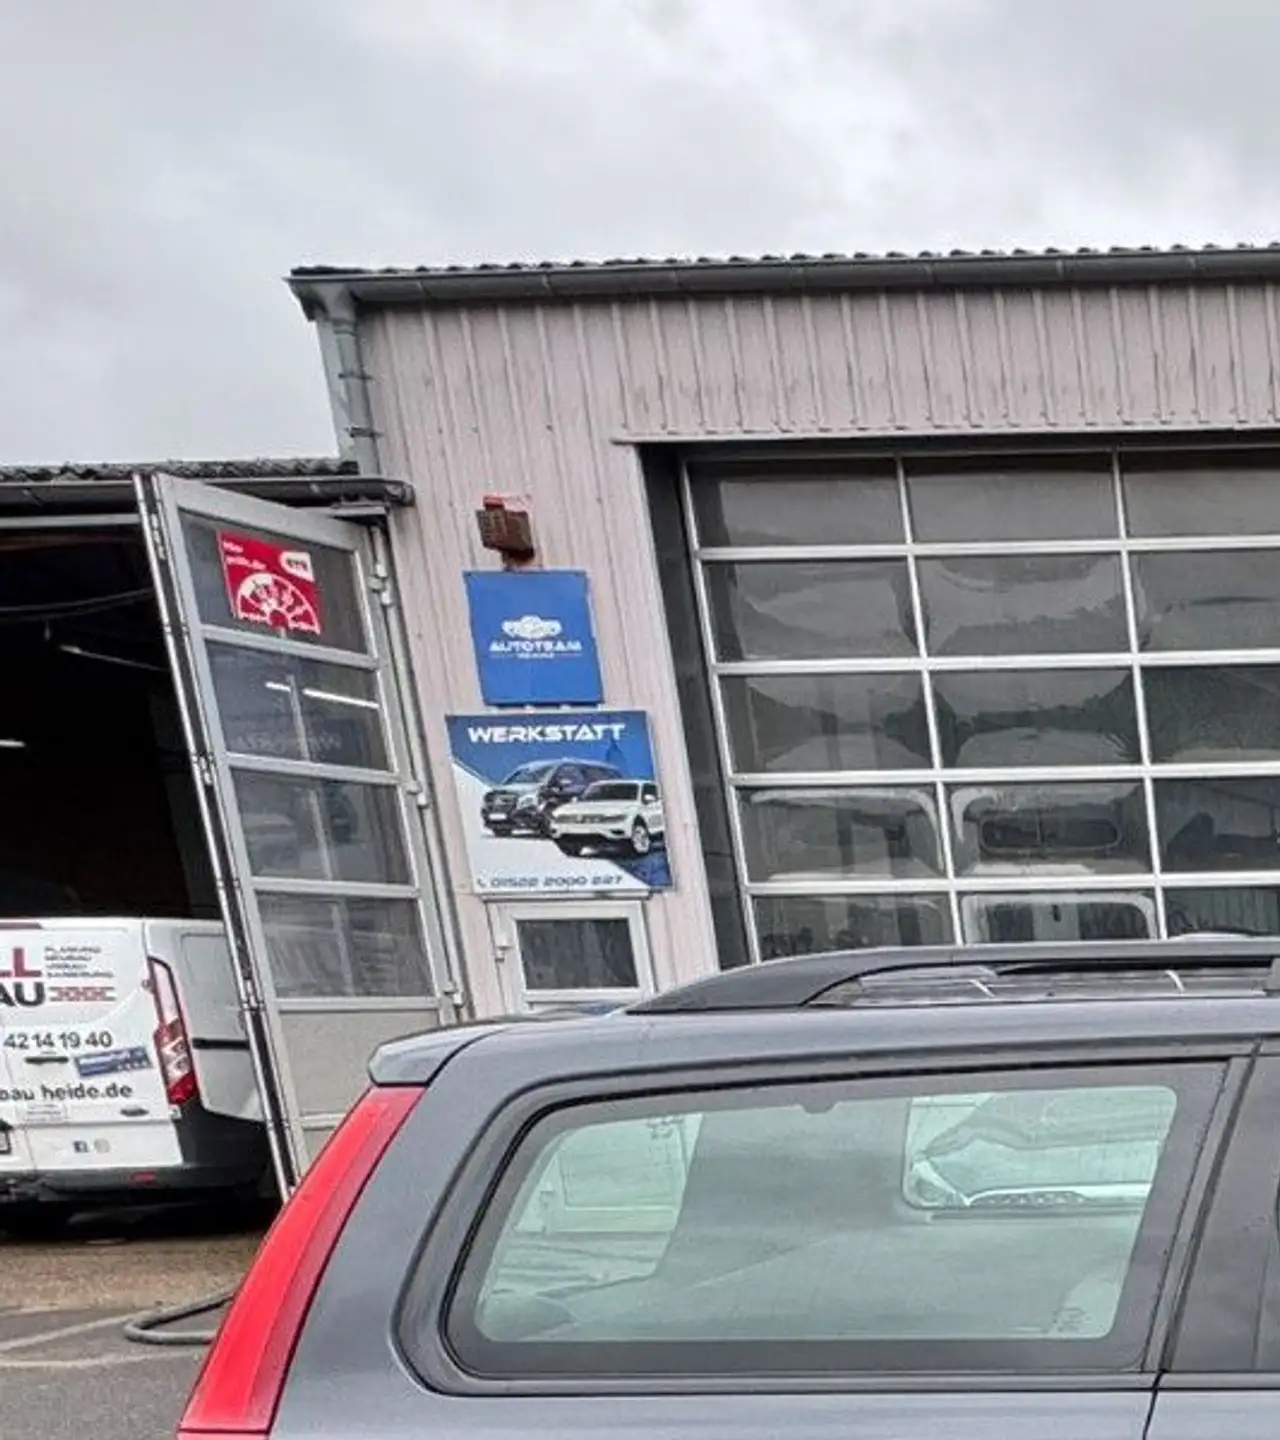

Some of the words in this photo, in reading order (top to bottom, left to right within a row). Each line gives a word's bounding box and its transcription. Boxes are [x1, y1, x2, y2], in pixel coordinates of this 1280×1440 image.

[489, 640, 583, 652] AUTOTEAM
[466, 722, 626, 743] WERKSTATT
[3, 1033, 29, 1050] 42
[32, 1033, 55, 1049] 14
[59, 1032, 81, 1048] 19
[85, 1031, 113, 1048] 40
